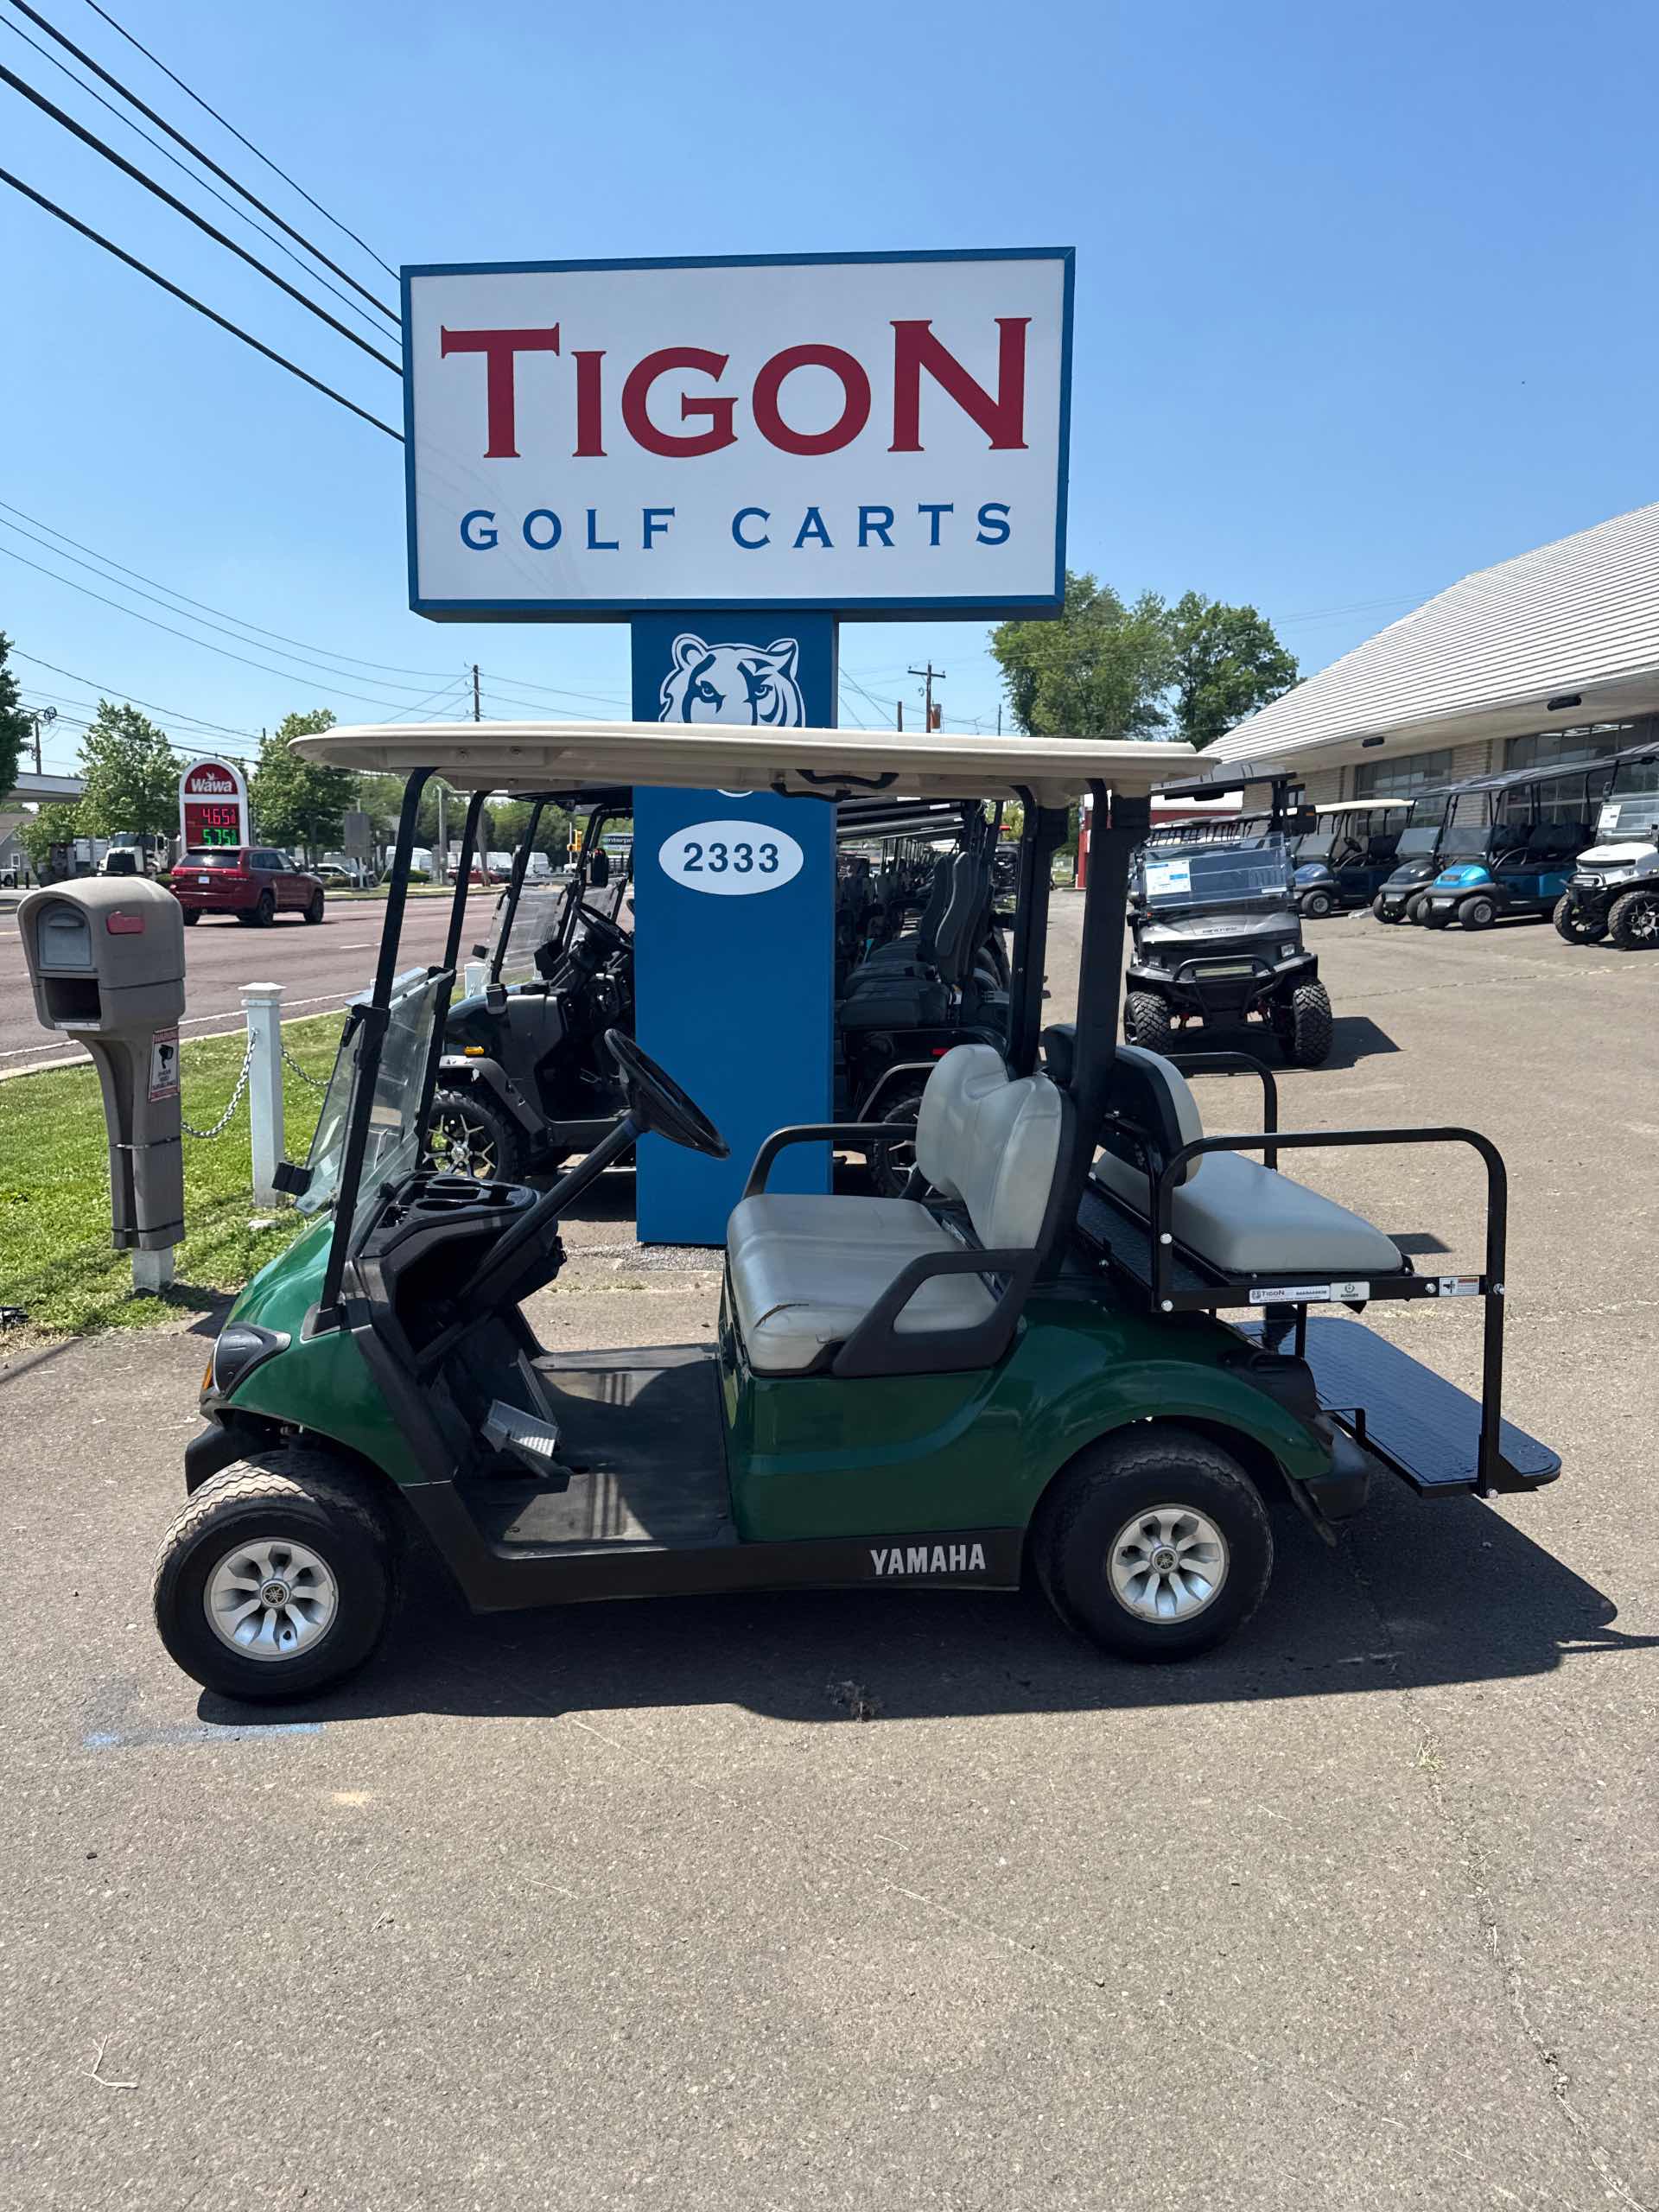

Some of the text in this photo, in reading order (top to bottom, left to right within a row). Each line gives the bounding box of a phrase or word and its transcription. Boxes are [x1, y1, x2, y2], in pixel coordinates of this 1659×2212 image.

[441, 316, 1032, 459] TIGON
[460, 502, 1011, 551] GOLF CARTS
[191, 779, 232, 792] Wawa
[683, 842, 779, 874] 2333
[870, 1543, 986, 1575] YAMAHA
